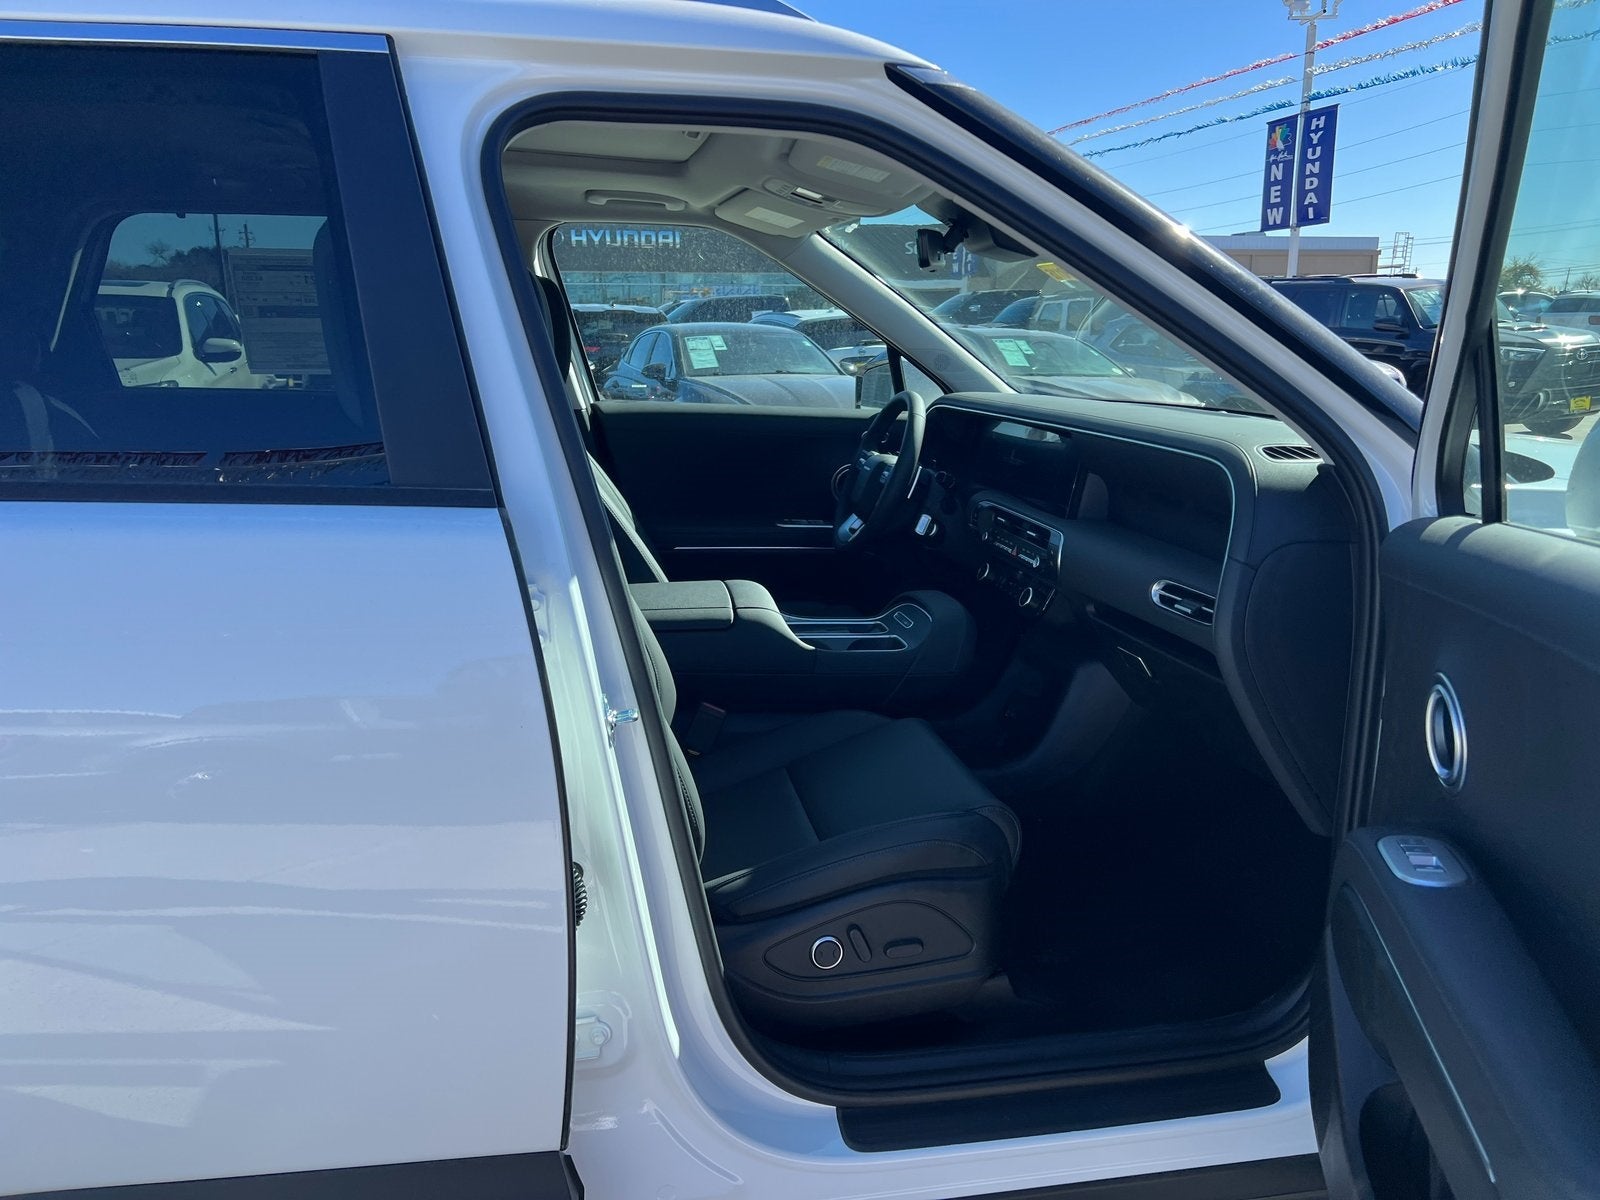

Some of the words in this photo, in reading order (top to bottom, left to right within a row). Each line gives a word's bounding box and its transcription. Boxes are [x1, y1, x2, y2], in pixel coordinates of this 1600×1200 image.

[1267, 163, 1283, 225] NEW
[1304, 115, 1325, 219] HYUNDAI
[570, 229, 681, 248] HYUNDAI
